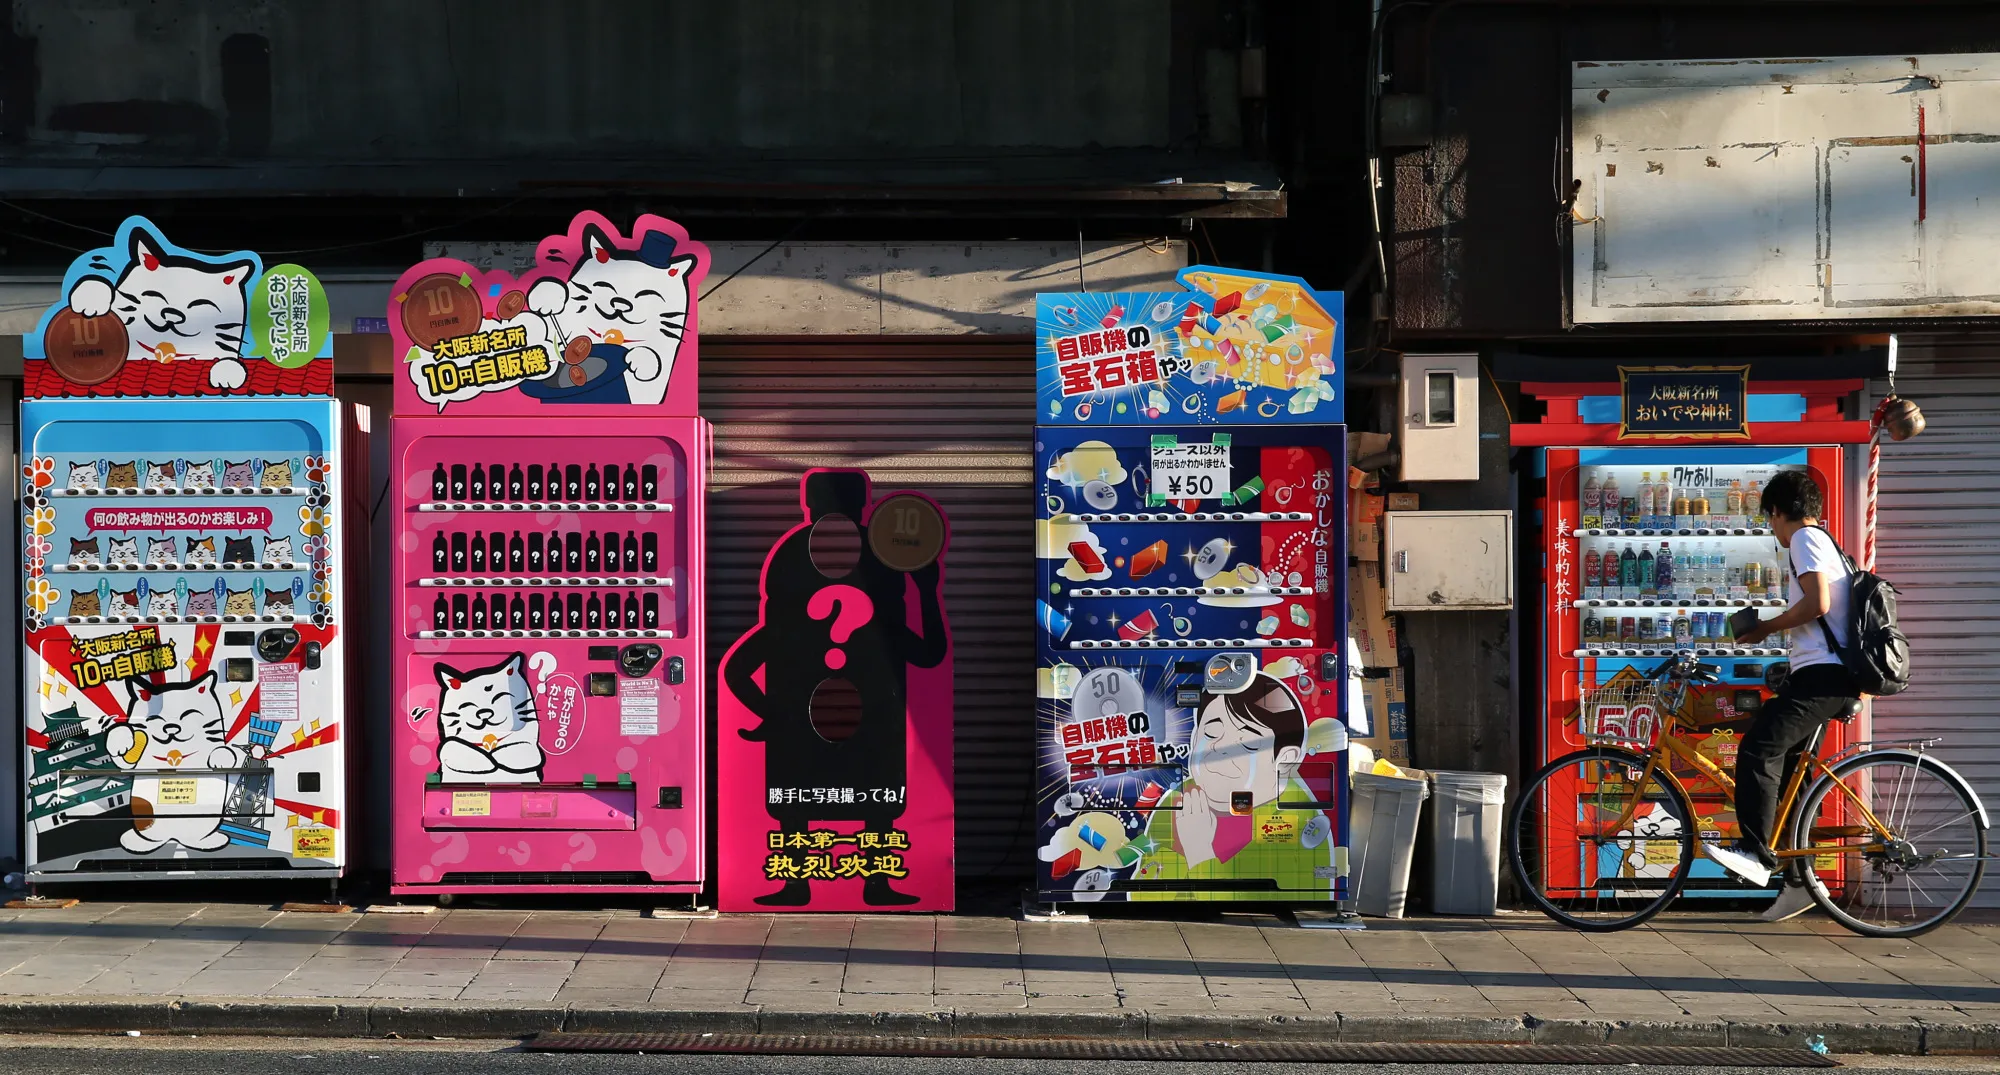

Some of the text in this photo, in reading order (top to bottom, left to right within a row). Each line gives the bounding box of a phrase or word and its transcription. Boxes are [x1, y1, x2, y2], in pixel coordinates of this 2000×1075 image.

[291, 276, 309, 351] 大阪新名所
[424, 286, 455, 316] 10
[69, 316, 100, 345] 10
[269, 275, 289, 360] おいでにゃ
[433, 327, 526, 360] 大阪新名所
[1056, 325, 1150, 362] 自販機の
[424, 348, 548, 394] 10円自販機
[1649, 384, 1720, 401] 大阪新名所
[1635, 403, 1733, 421] おいでや神社
[1152, 444, 1227, 456] ジュース以外
[1152, 458, 1227, 470] 何が出るかわかりません
[1168, 475, 1214, 496] ¥50
[1673, 466, 1714, 487] ワケあり
[93, 511, 266, 527] 何の飲み物が出るのかお楽しみ！
[1310, 470, 1332, 593] おかしな自販機
[1553, 518, 1572, 616] 美味的饮料
[79, 627, 156, 658] 大阪新名所
[72, 645, 175, 688] 10円自販機
[1091, 671, 1120, 699] 50
[547, 683, 561, 721] かにゃ
[554, 685, 577, 750] 何が出るの
[1062, 711, 1150, 748] 自販機の
[768, 786, 906, 804] 勝手に写真撮ってね!
[769, 831, 909, 849] 日本第一便宜
[765, 854, 907, 879] 热烈欢迎
[1085, 871, 1101, 884] 50
